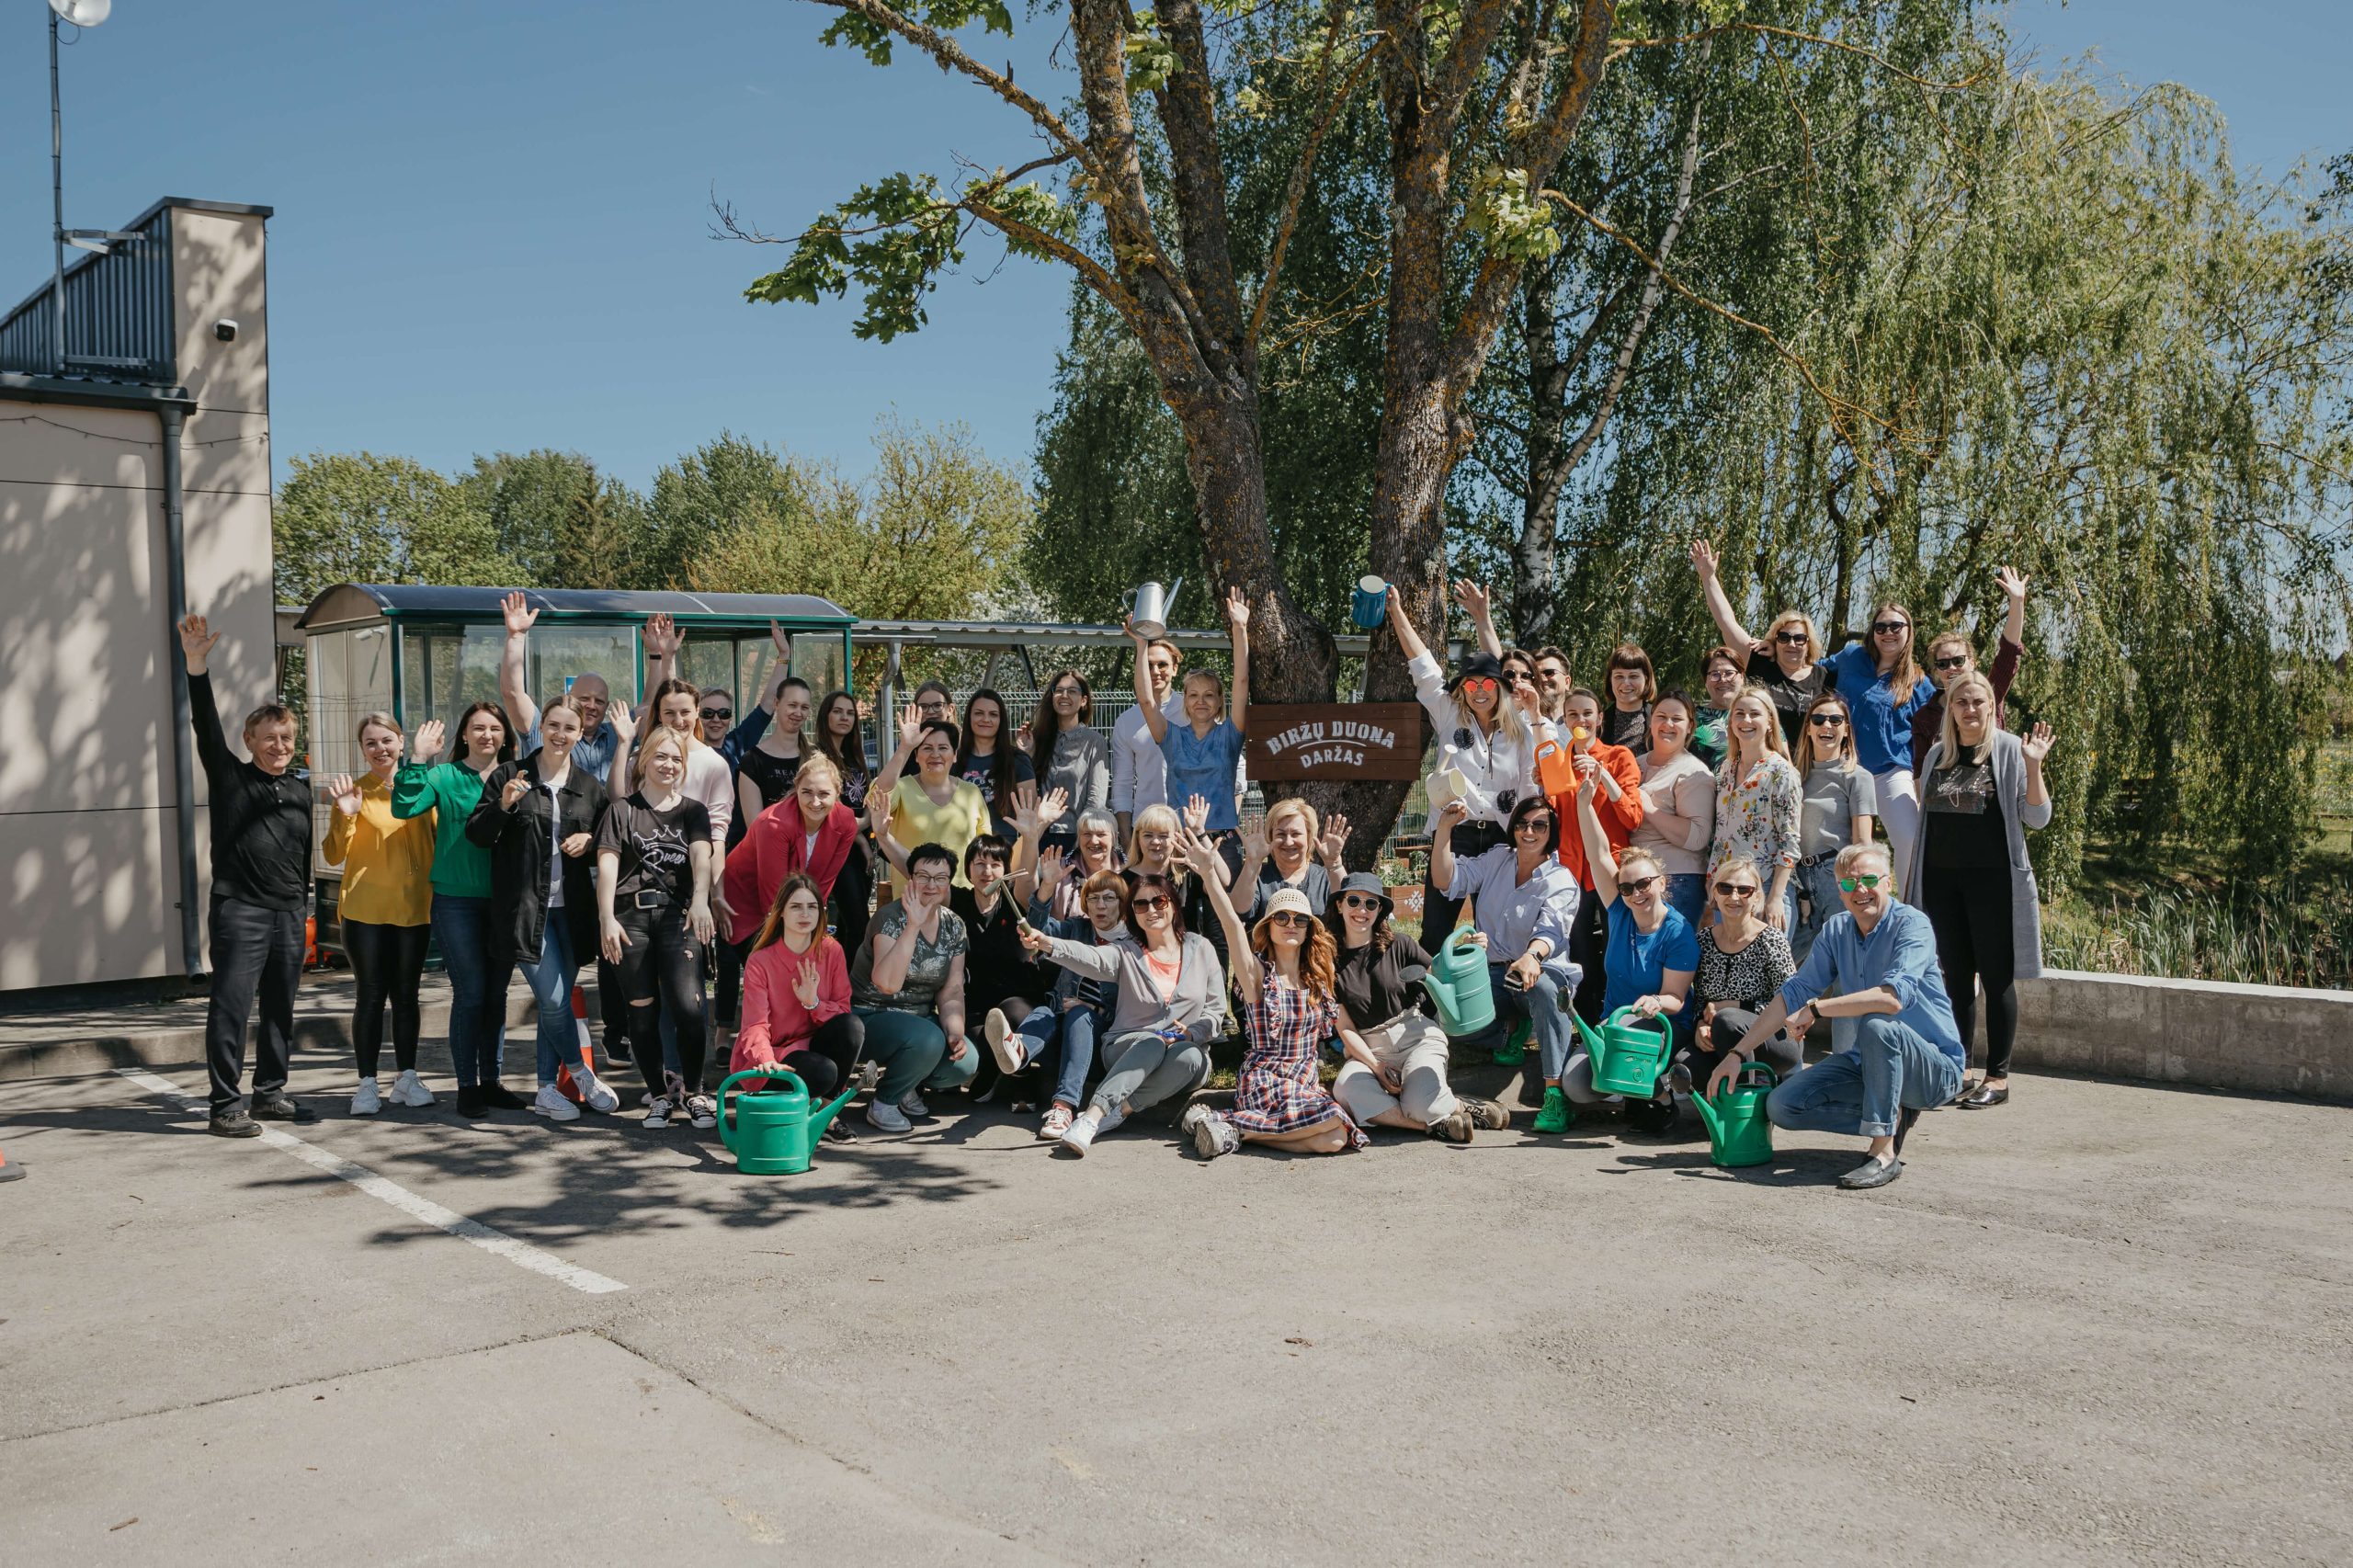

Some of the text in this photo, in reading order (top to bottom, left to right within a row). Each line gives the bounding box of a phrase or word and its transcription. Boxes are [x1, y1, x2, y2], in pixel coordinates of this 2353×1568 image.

[1266, 721, 1395, 755] BIRŽŲ DUONA
[1300, 744, 1364, 768] DARŽAS
